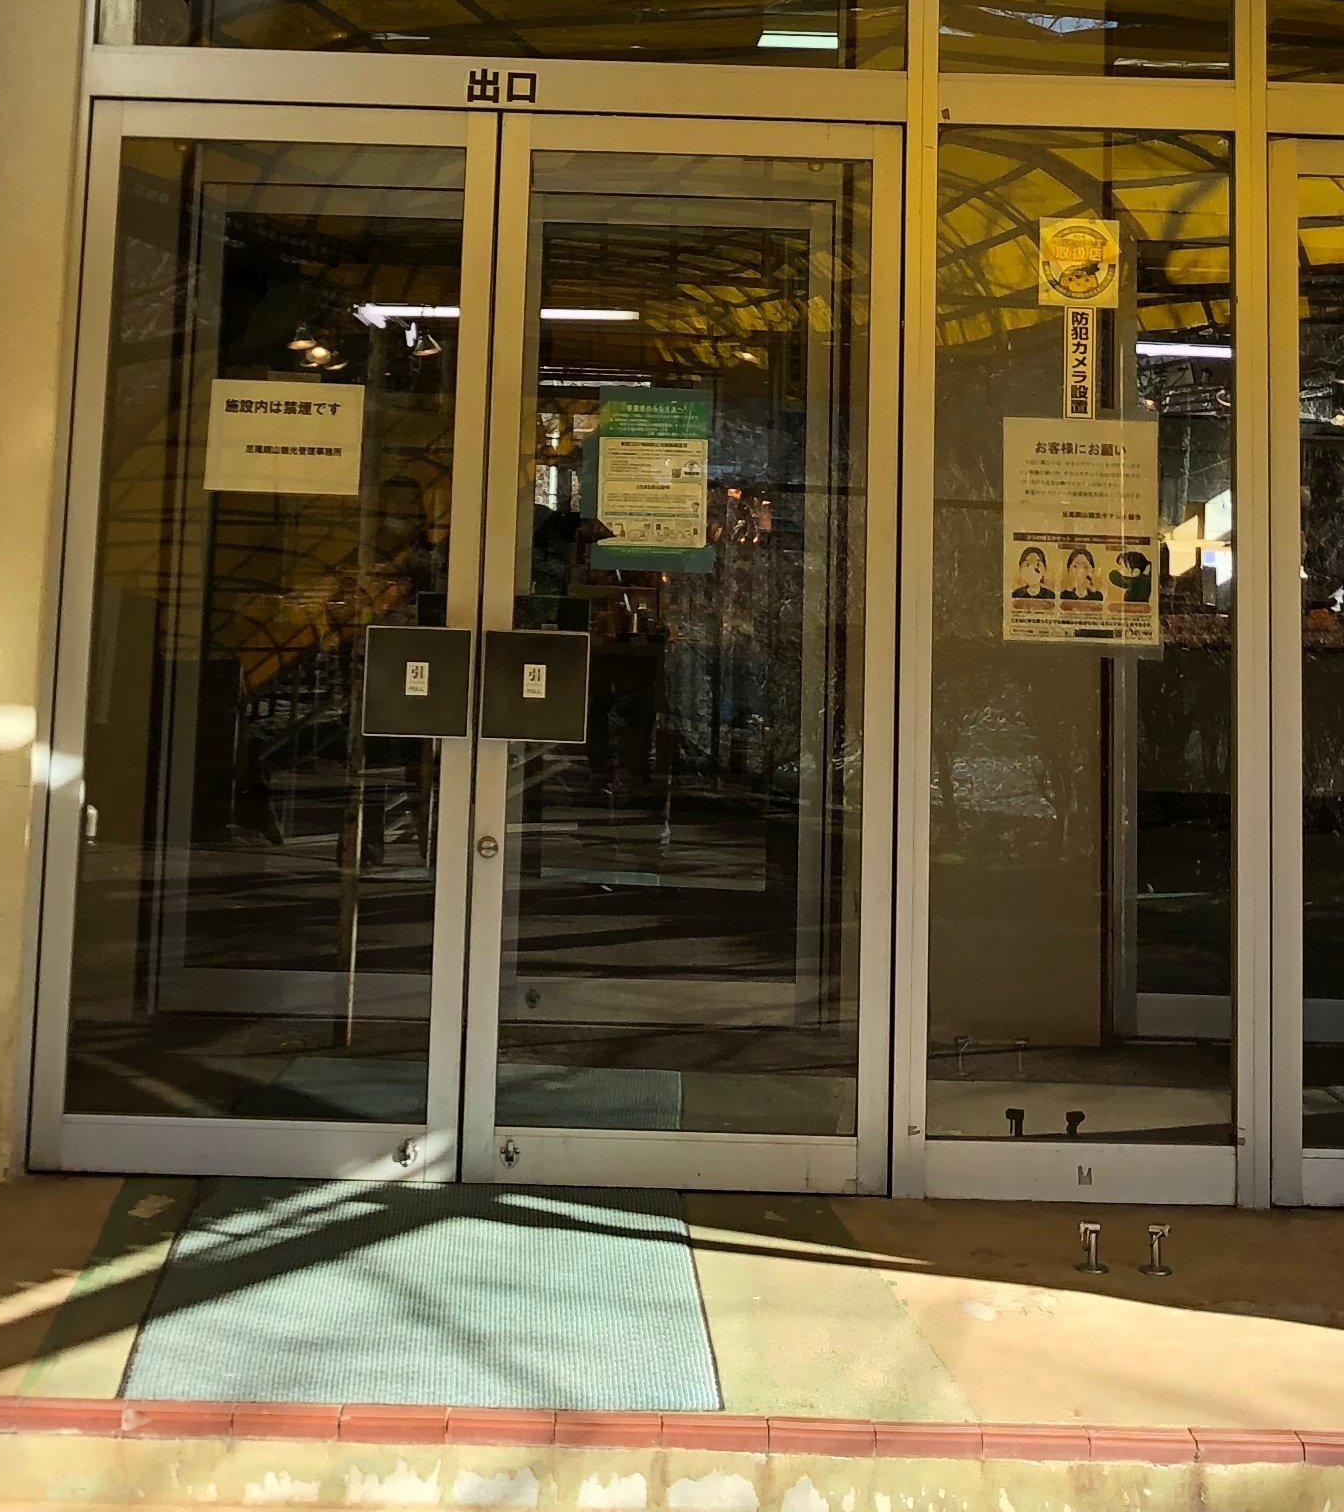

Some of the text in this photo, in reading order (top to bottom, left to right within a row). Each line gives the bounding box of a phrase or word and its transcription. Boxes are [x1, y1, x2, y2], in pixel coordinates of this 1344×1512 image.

[467, 68, 537, 104] 出口
[1070, 310, 1090, 415] 防犯カメラ設置
[224, 398, 341, 416] 施設内は禁煙です
[1034, 441, 1127, 457] お客様にお願い
